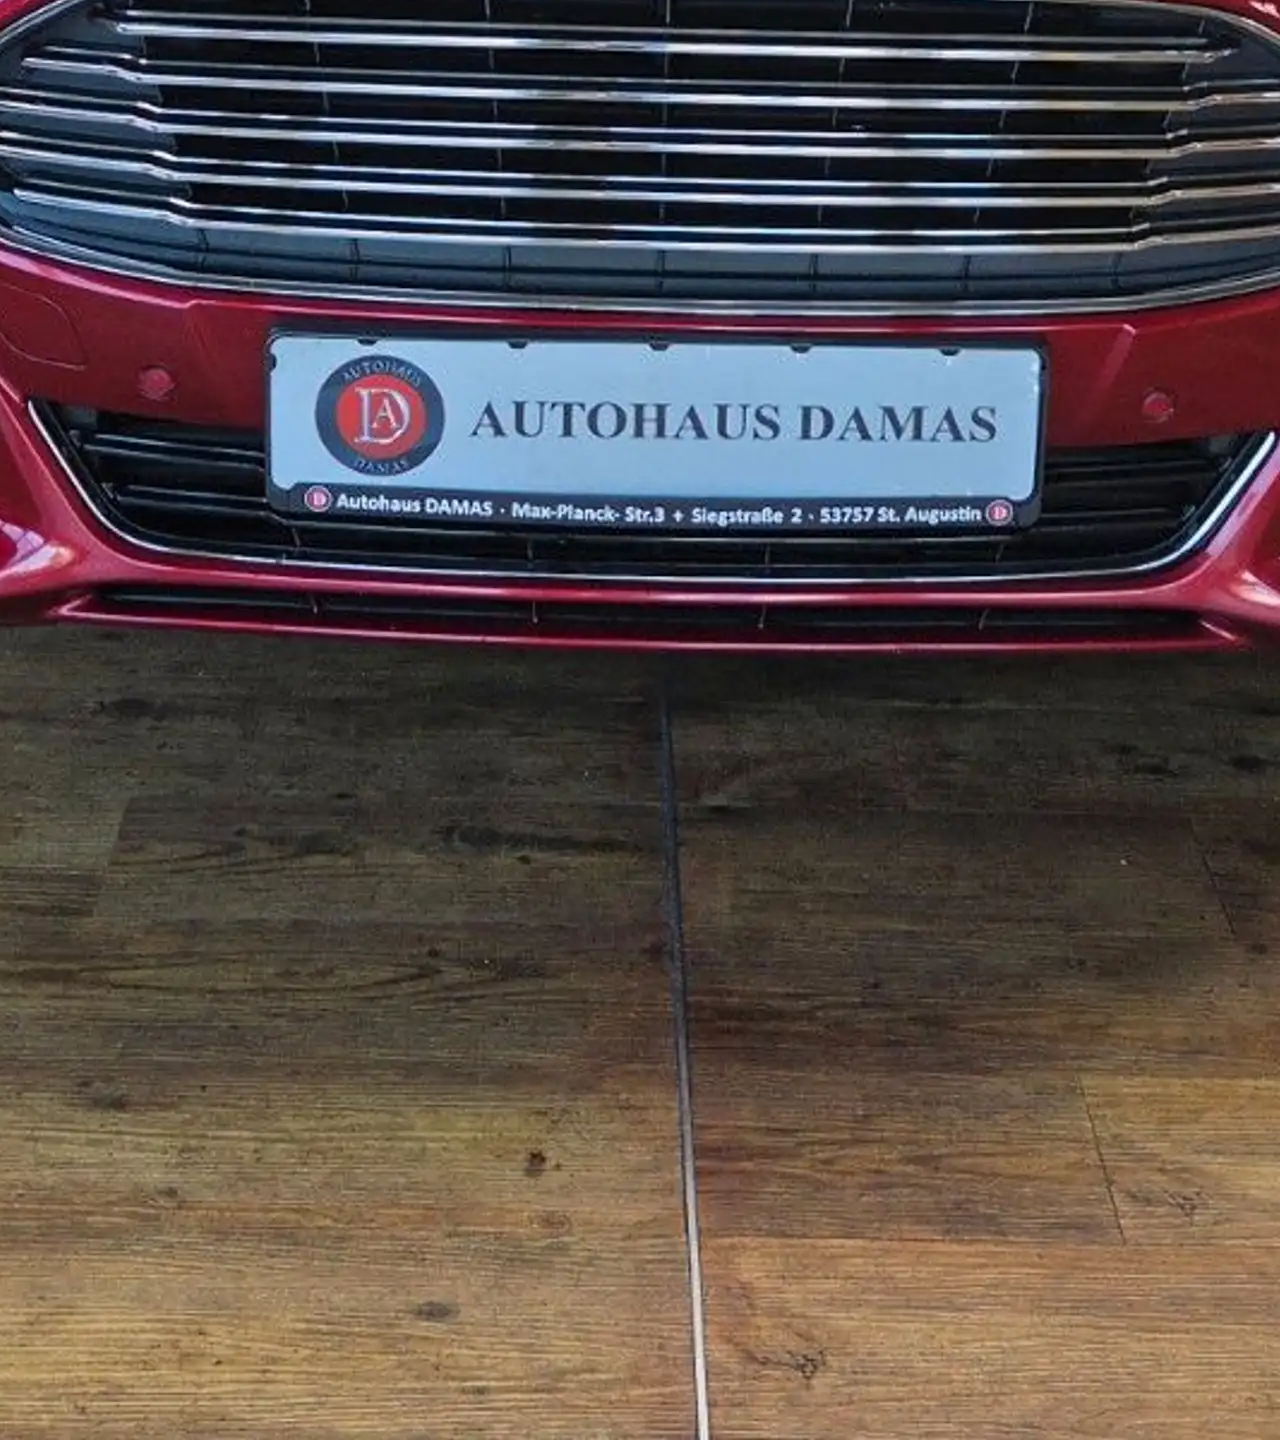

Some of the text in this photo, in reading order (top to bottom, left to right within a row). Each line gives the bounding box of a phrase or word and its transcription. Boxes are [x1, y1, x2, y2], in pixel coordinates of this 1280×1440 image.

[468, 401, 998, 443] AUTOHAUS DAMAS
[336, 493, 421, 512] Autohaus
[425, 496, 494, 517] DAMAS
[690, 506, 783, 527] Siegstraße
[791, 507, 803, 523] 2
[820, 505, 874, 523] 53757
[877, 506, 901, 523] St.
[904, 504, 982, 526] Augustin
